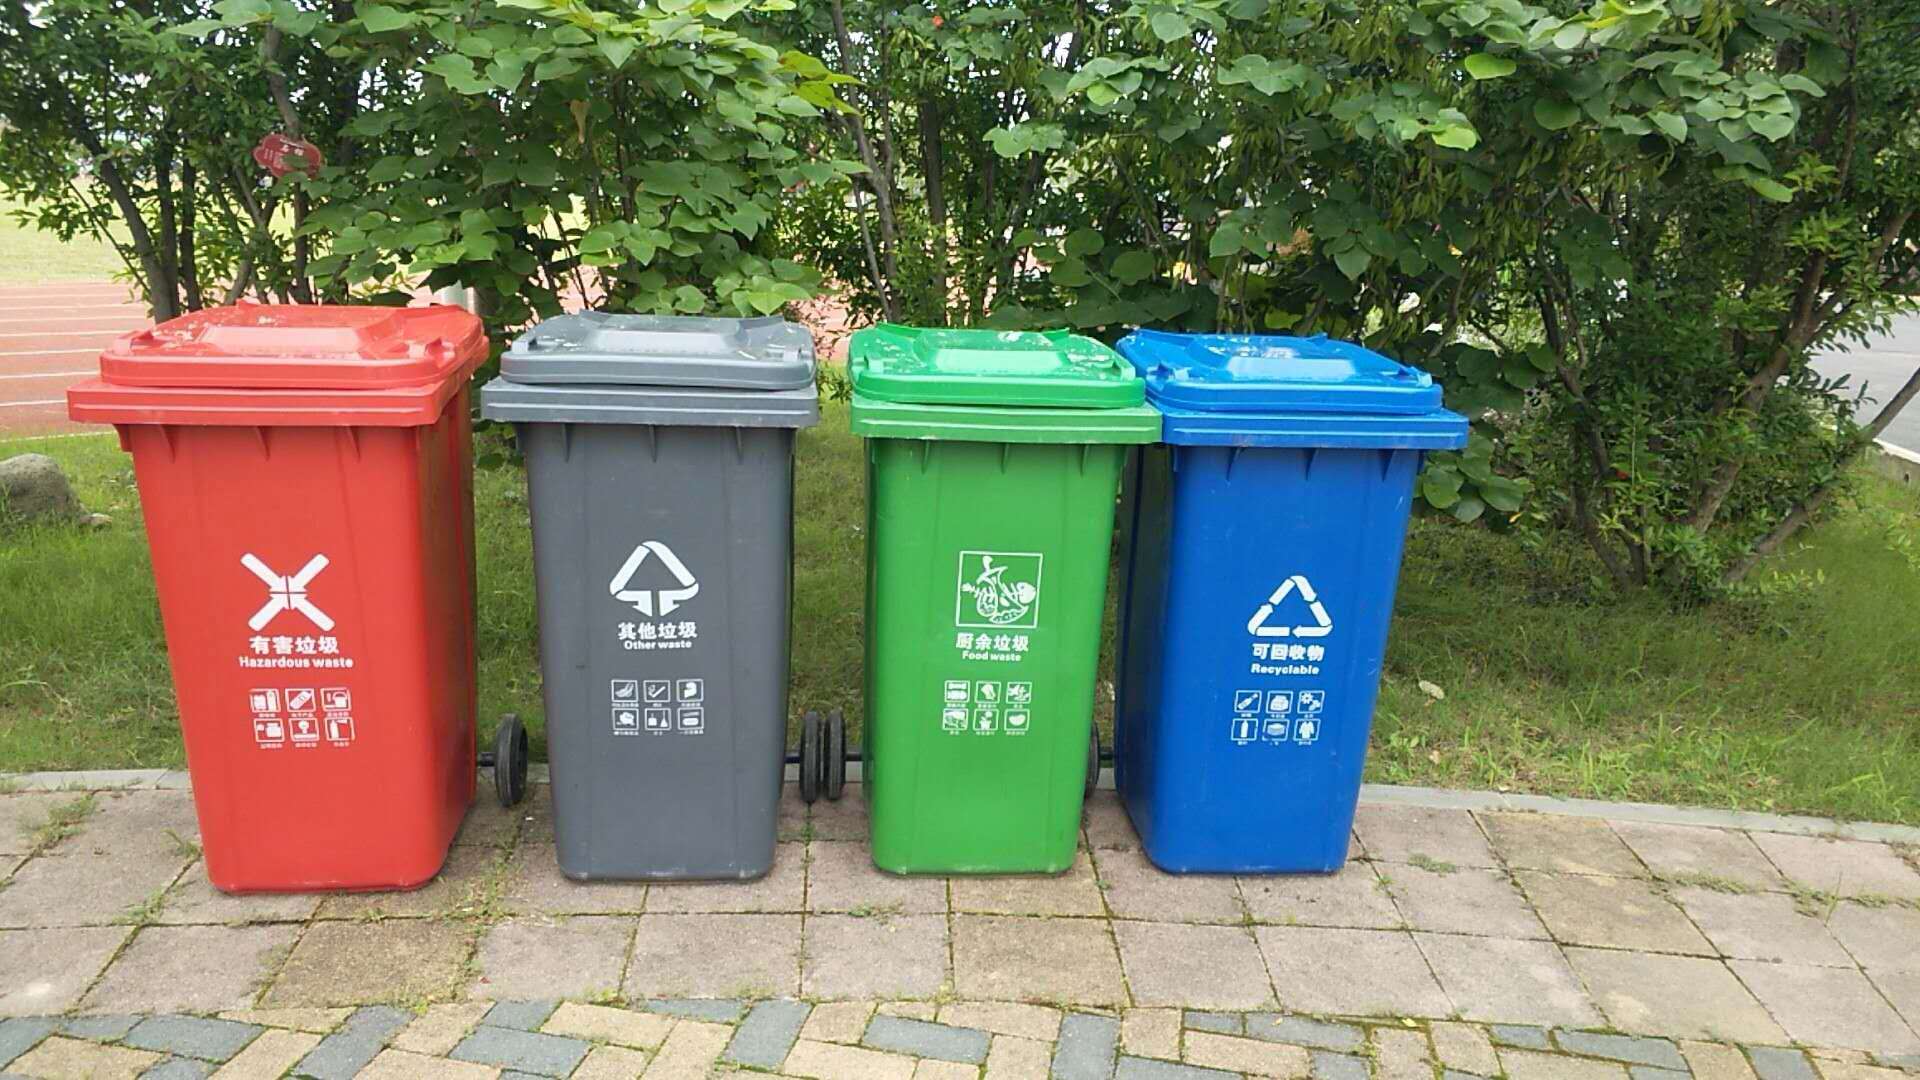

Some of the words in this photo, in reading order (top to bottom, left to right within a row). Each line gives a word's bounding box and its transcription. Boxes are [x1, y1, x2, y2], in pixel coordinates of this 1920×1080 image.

[618, 621, 697, 640] 其他垃圾
[249, 635, 340, 654] 有害垃圾
[624, 640, 656, 650] Other
[658, 640, 692, 649] waste
[956, 633, 1029, 652] 厨余垃圾
[962, 650, 989, 660] Food
[990, 652, 1021, 661] waste
[1252, 643, 1325, 661] 可回收物
[239, 656, 309, 668] Hazardous
[312, 657, 354, 668] waste
[1251, 663, 1320, 676] Recyclable
